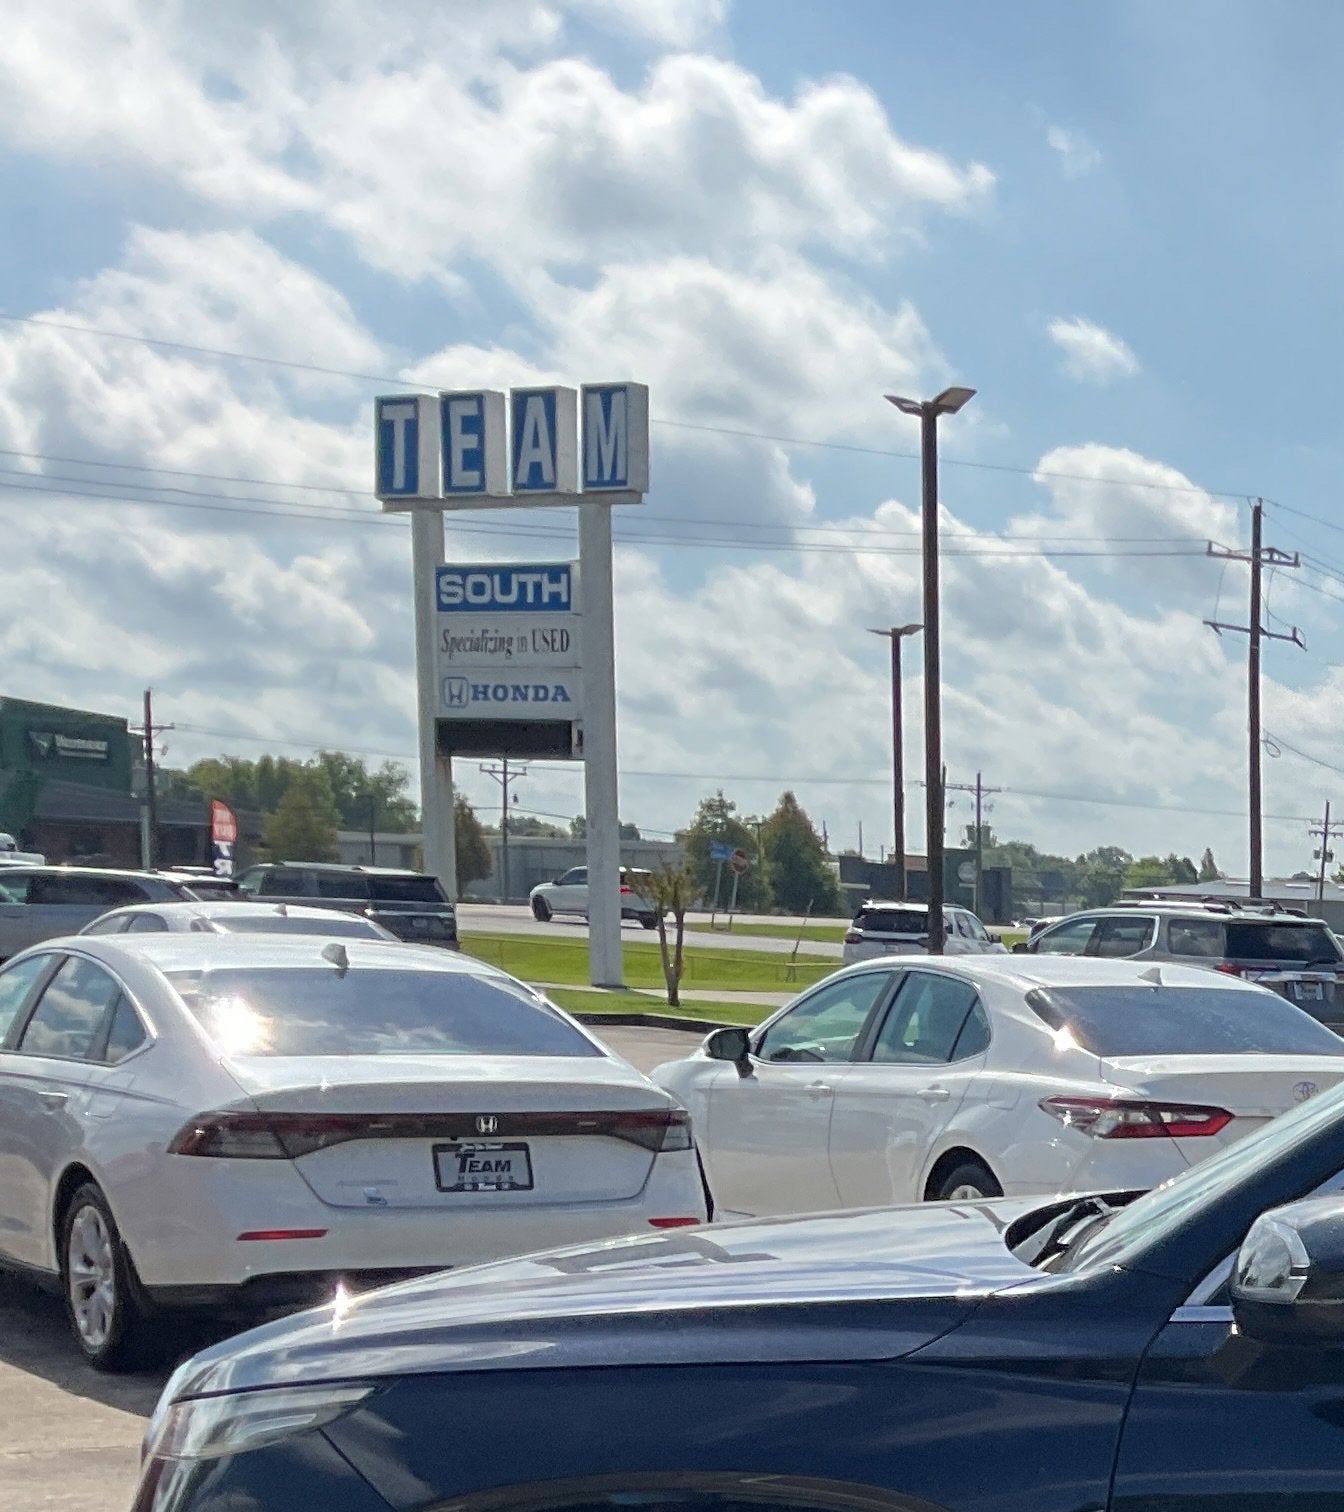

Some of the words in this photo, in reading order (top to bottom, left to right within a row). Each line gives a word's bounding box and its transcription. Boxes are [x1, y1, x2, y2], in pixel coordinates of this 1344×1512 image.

[381, 391, 627, 491] TEAM
[440, 572, 569, 604] SOUTH
[441, 629, 513, 660] Specializing
[516, 628, 528, 653] in
[532, 628, 570, 653] USED
[471, 684, 572, 702] HONDA
